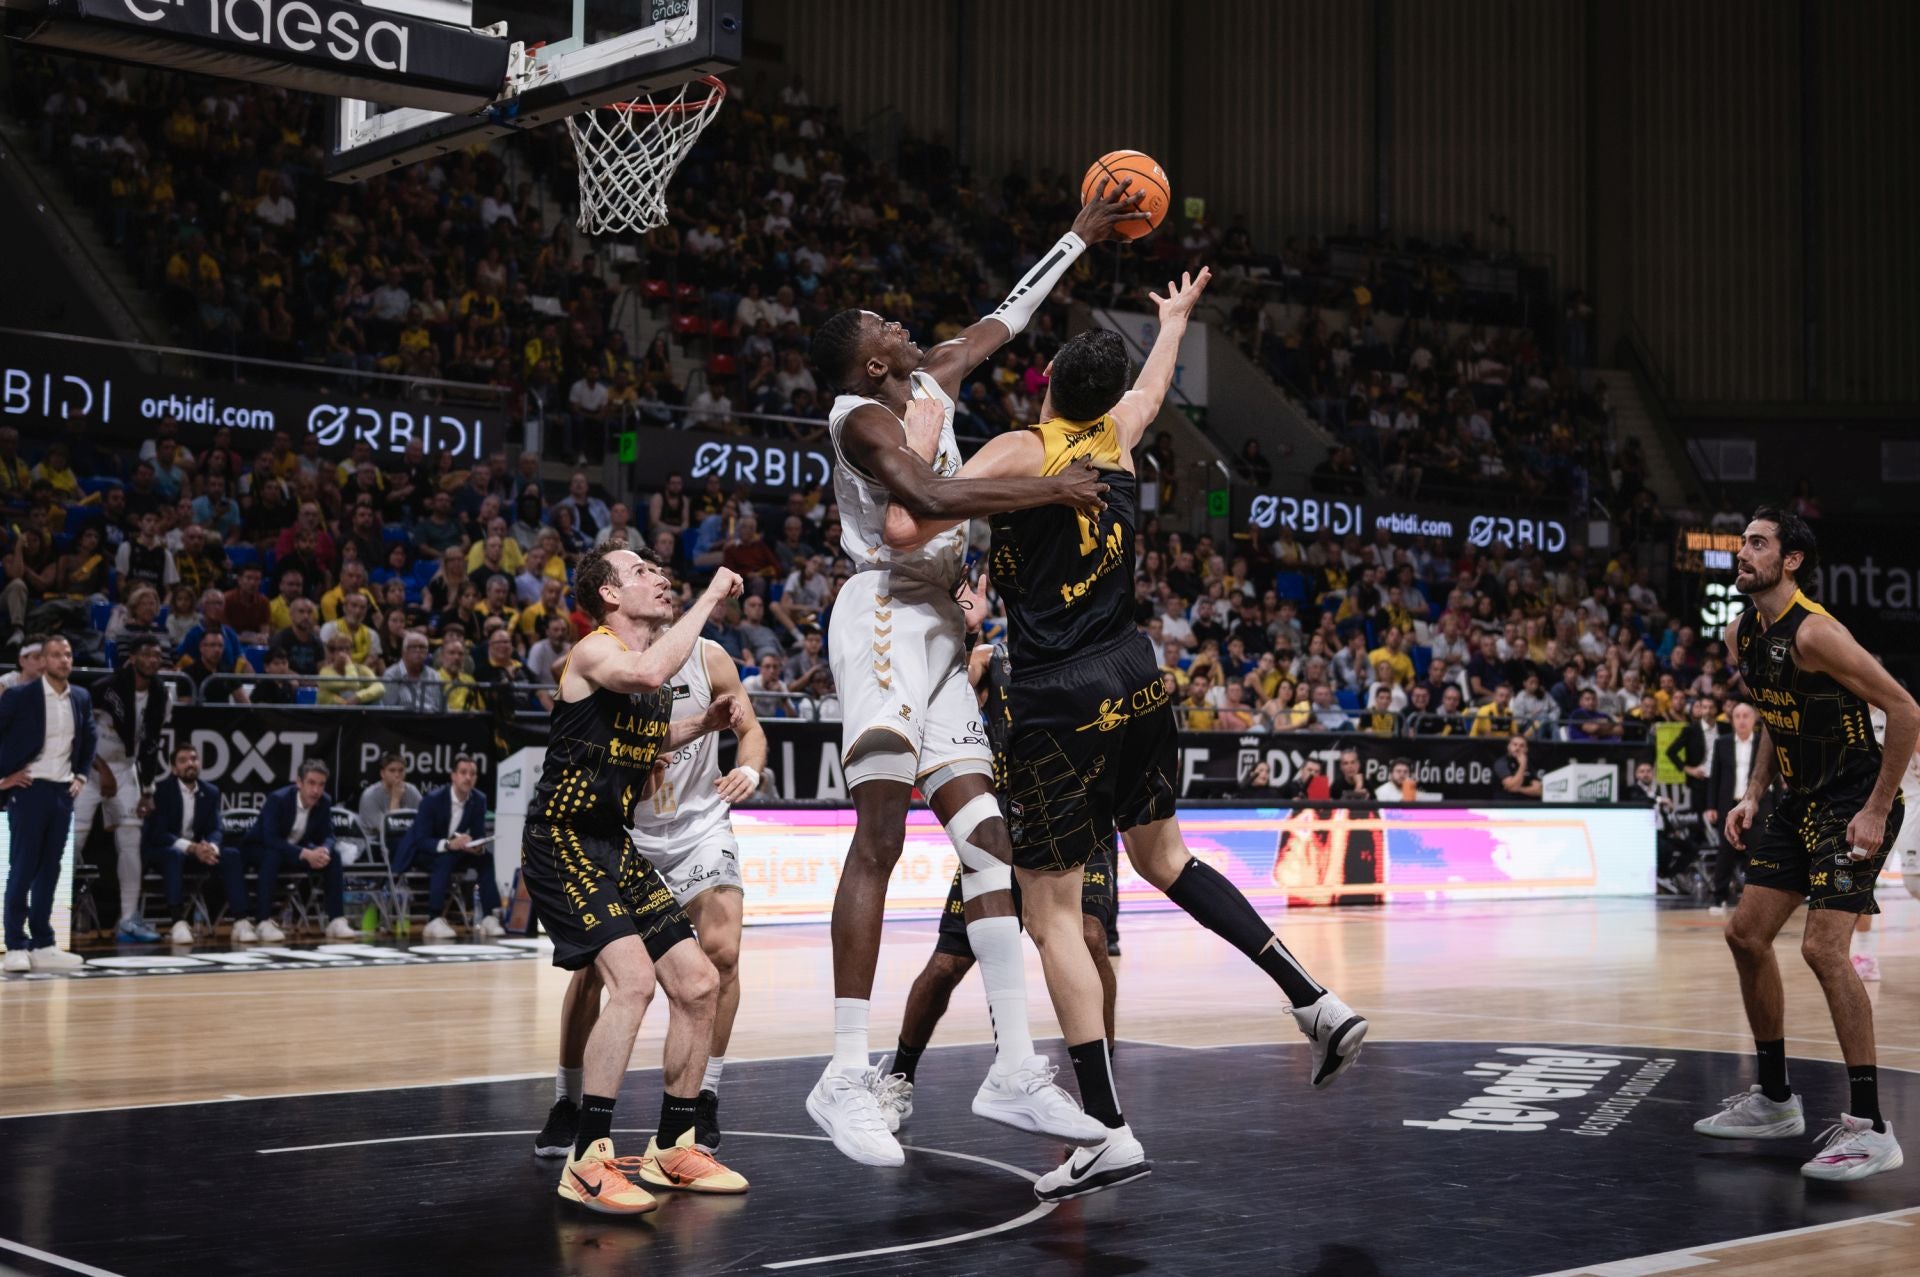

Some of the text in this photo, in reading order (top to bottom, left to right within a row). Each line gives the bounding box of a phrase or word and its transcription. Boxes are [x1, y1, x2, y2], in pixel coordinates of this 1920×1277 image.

[652, 0, 688, 21] endes
[141, 394, 275, 431] orbidi.com
[1375, 513, 1450, 537] orbidi.com
[191, 729, 319, 784] DXT
[359, 743, 488, 776] Pbelln
[680, 869, 721, 893] LEXUS
